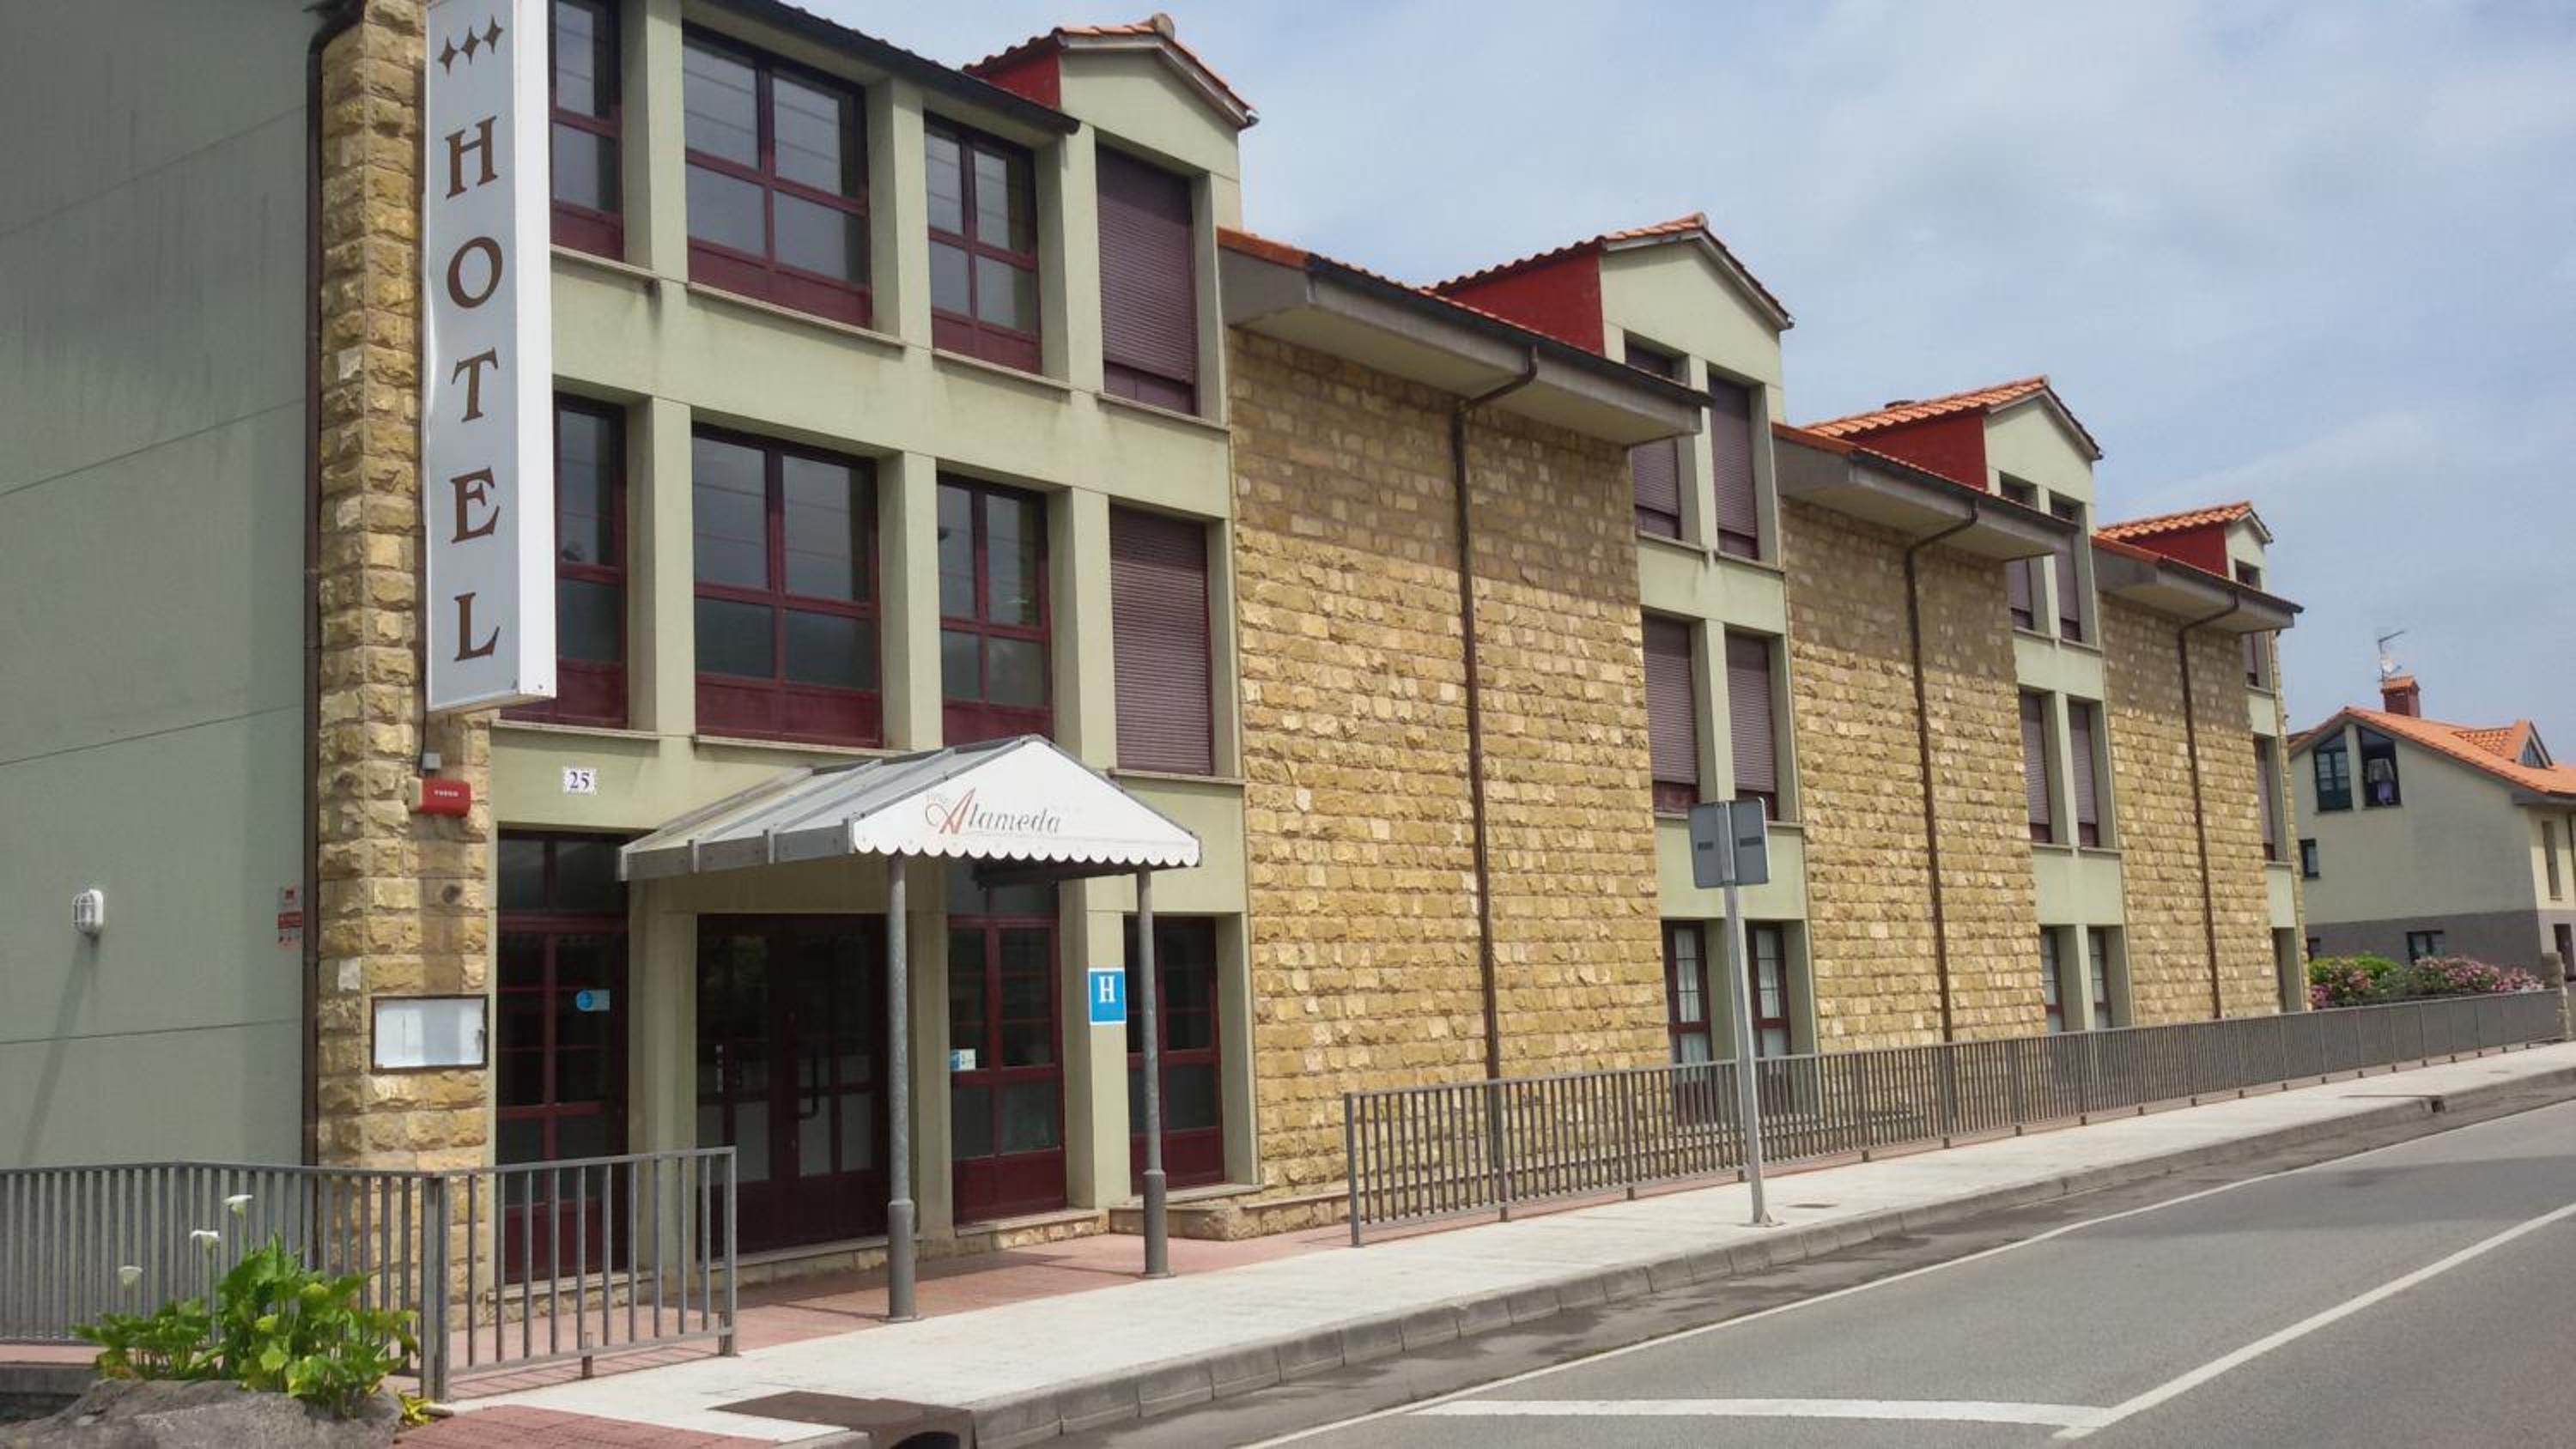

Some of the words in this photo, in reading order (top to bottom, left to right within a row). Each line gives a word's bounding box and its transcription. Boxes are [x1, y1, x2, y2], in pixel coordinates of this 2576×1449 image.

[446, 115, 504, 662] HOTEL
[569, 771, 590, 790] 25
[925, 787, 1060, 834] Alameda
[1098, 974, 1115, 1003] H
